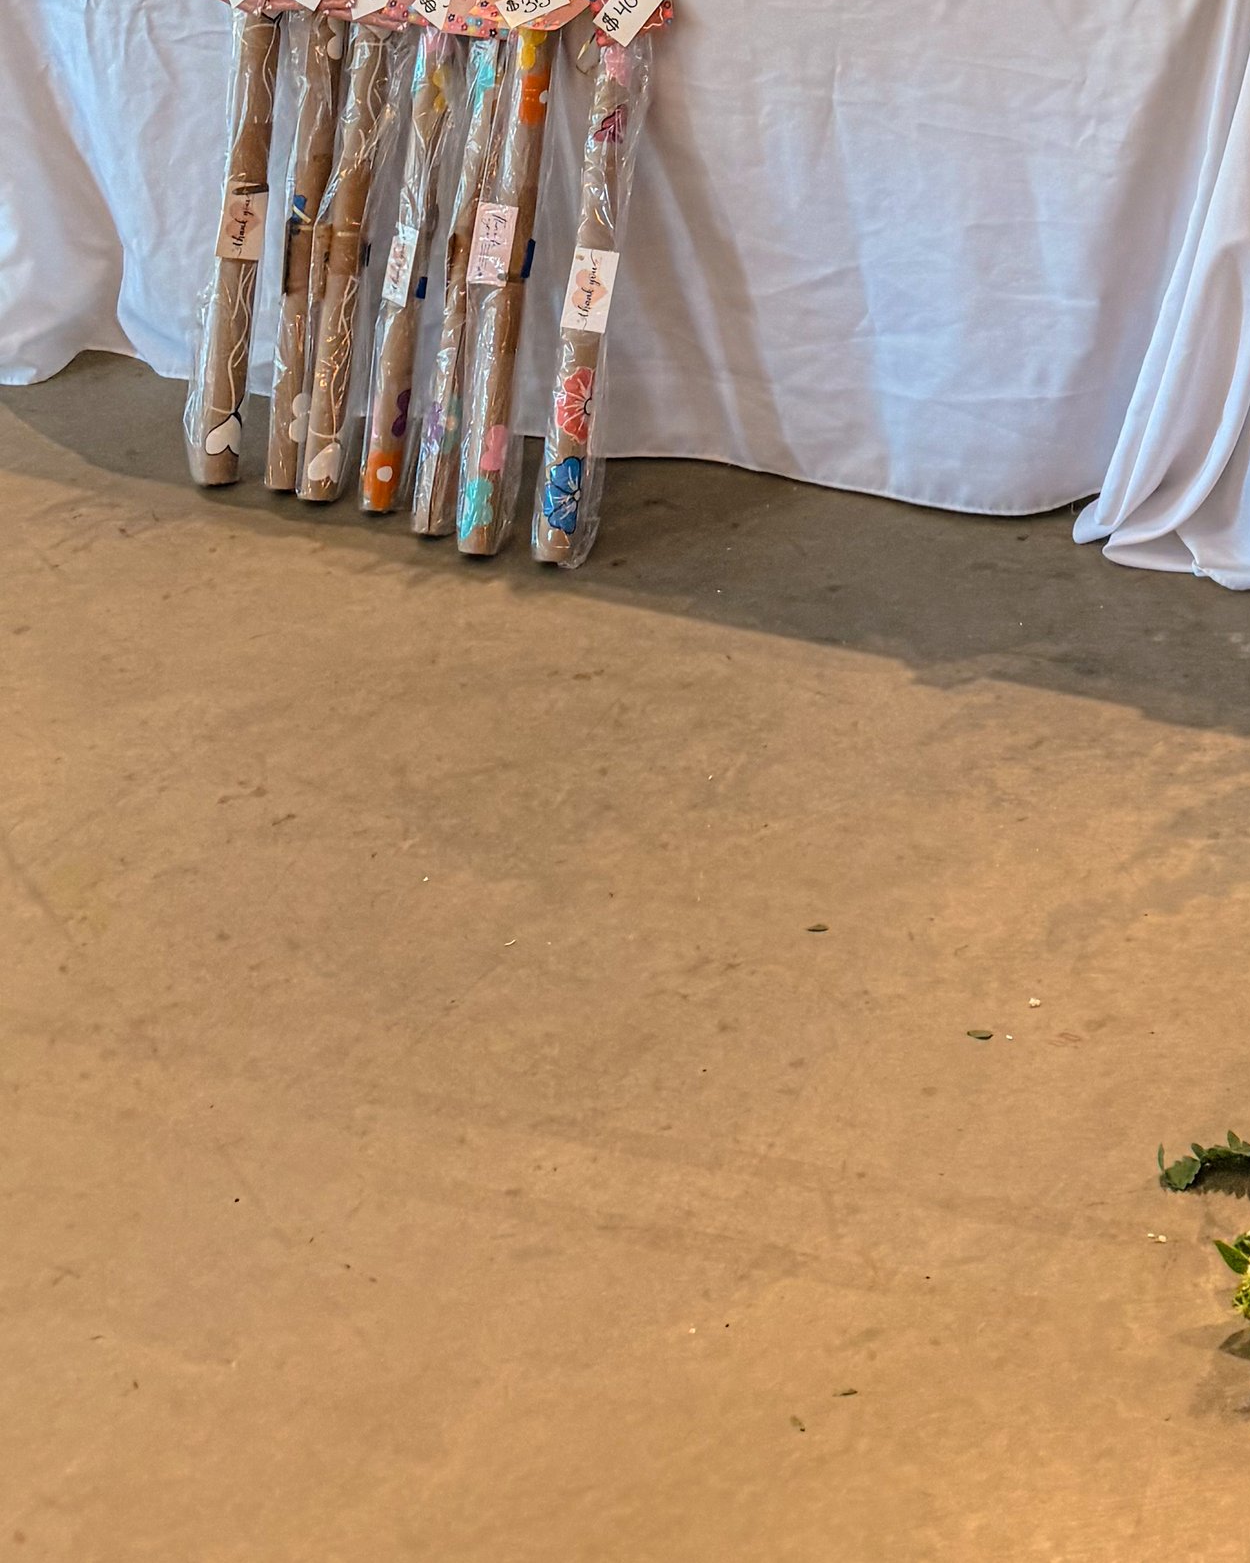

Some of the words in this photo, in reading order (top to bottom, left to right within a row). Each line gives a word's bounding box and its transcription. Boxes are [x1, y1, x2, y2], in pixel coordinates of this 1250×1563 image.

[232, 218, 248, 246] thank
[577, 286, 594, 317] thank
[589, 266, 601, 287] you
